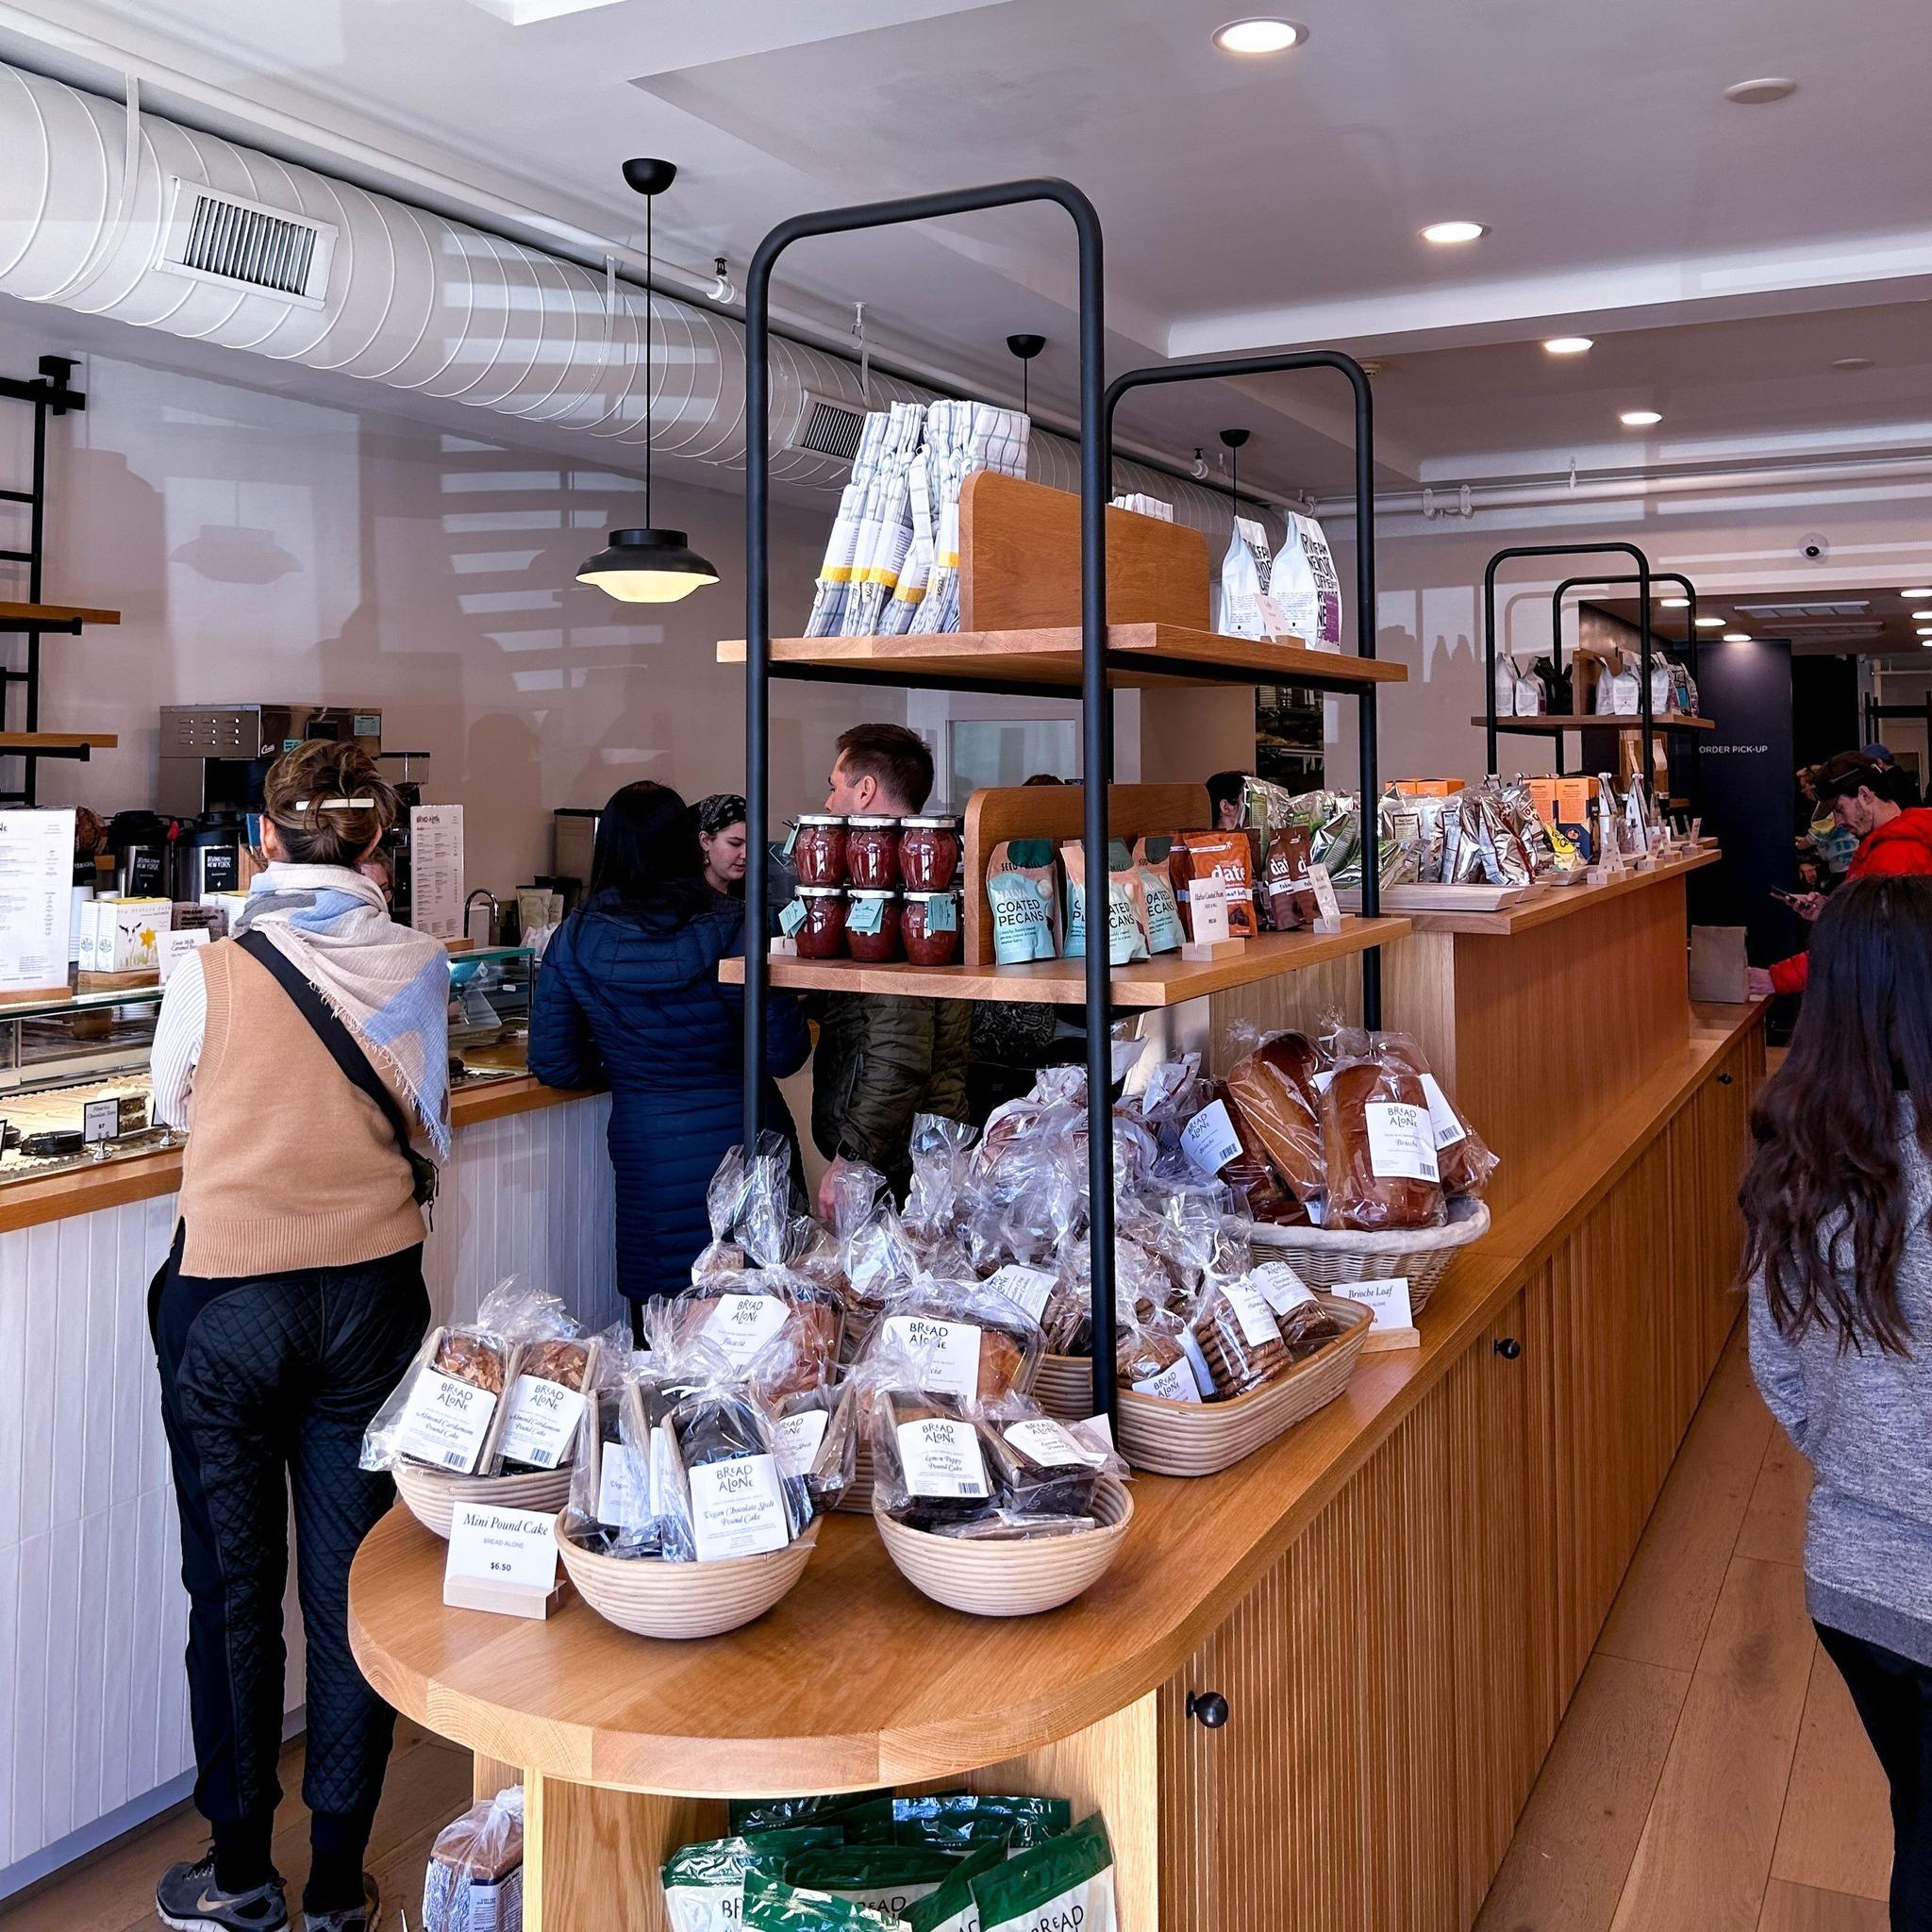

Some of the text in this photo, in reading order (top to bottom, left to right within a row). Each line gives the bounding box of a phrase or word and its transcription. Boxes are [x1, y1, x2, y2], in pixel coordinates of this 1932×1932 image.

[1698, 744, 1768, 754] ORDER PICK-UP
[1146, 890, 1171, 906] OATED
[996, 899, 1041, 914] COATED
[1147, 900, 1176, 917] ECANS
[998, 911, 1044, 926] PECANS
[1388, 1106, 1417, 1118] BREAD
[1390, 1115, 1418, 1128] ALONE
[1348, 1285, 1394, 1299] Brioche Loaf
[737, 1299, 763, 1311] BREAD
[731, 1309, 758, 1324] ALONE
[909, 1322, 949, 1337] BREAD
[1154, 1372, 1177, 1391] BREAD
[1158, 1380, 1180, 1397] ALONE
[441, 1382, 474, 1400] BREAD
[534, 1384, 564, 1401] BREAD
[437, 1392, 469, 1411] ALONE
[529, 1394, 559, 1411] ALONE
[923, 1423, 955, 1434] BREAD
[924, 1431, 957, 1443] ALONE
[717, 1464, 753, 1479] BREAD
[719, 1475, 755, 1492] ALONE
[703, 1509, 724, 1520] Vegan
[725, 1504, 758, 1517] Chocolate
[721, 1512, 762, 1525] Pound Cake
[462, 1512, 549, 1536] Mini Pound Cake
[483, 1538, 525, 1549] BREAD ALONE
[491, 1561, 512, 1572] $6.50
